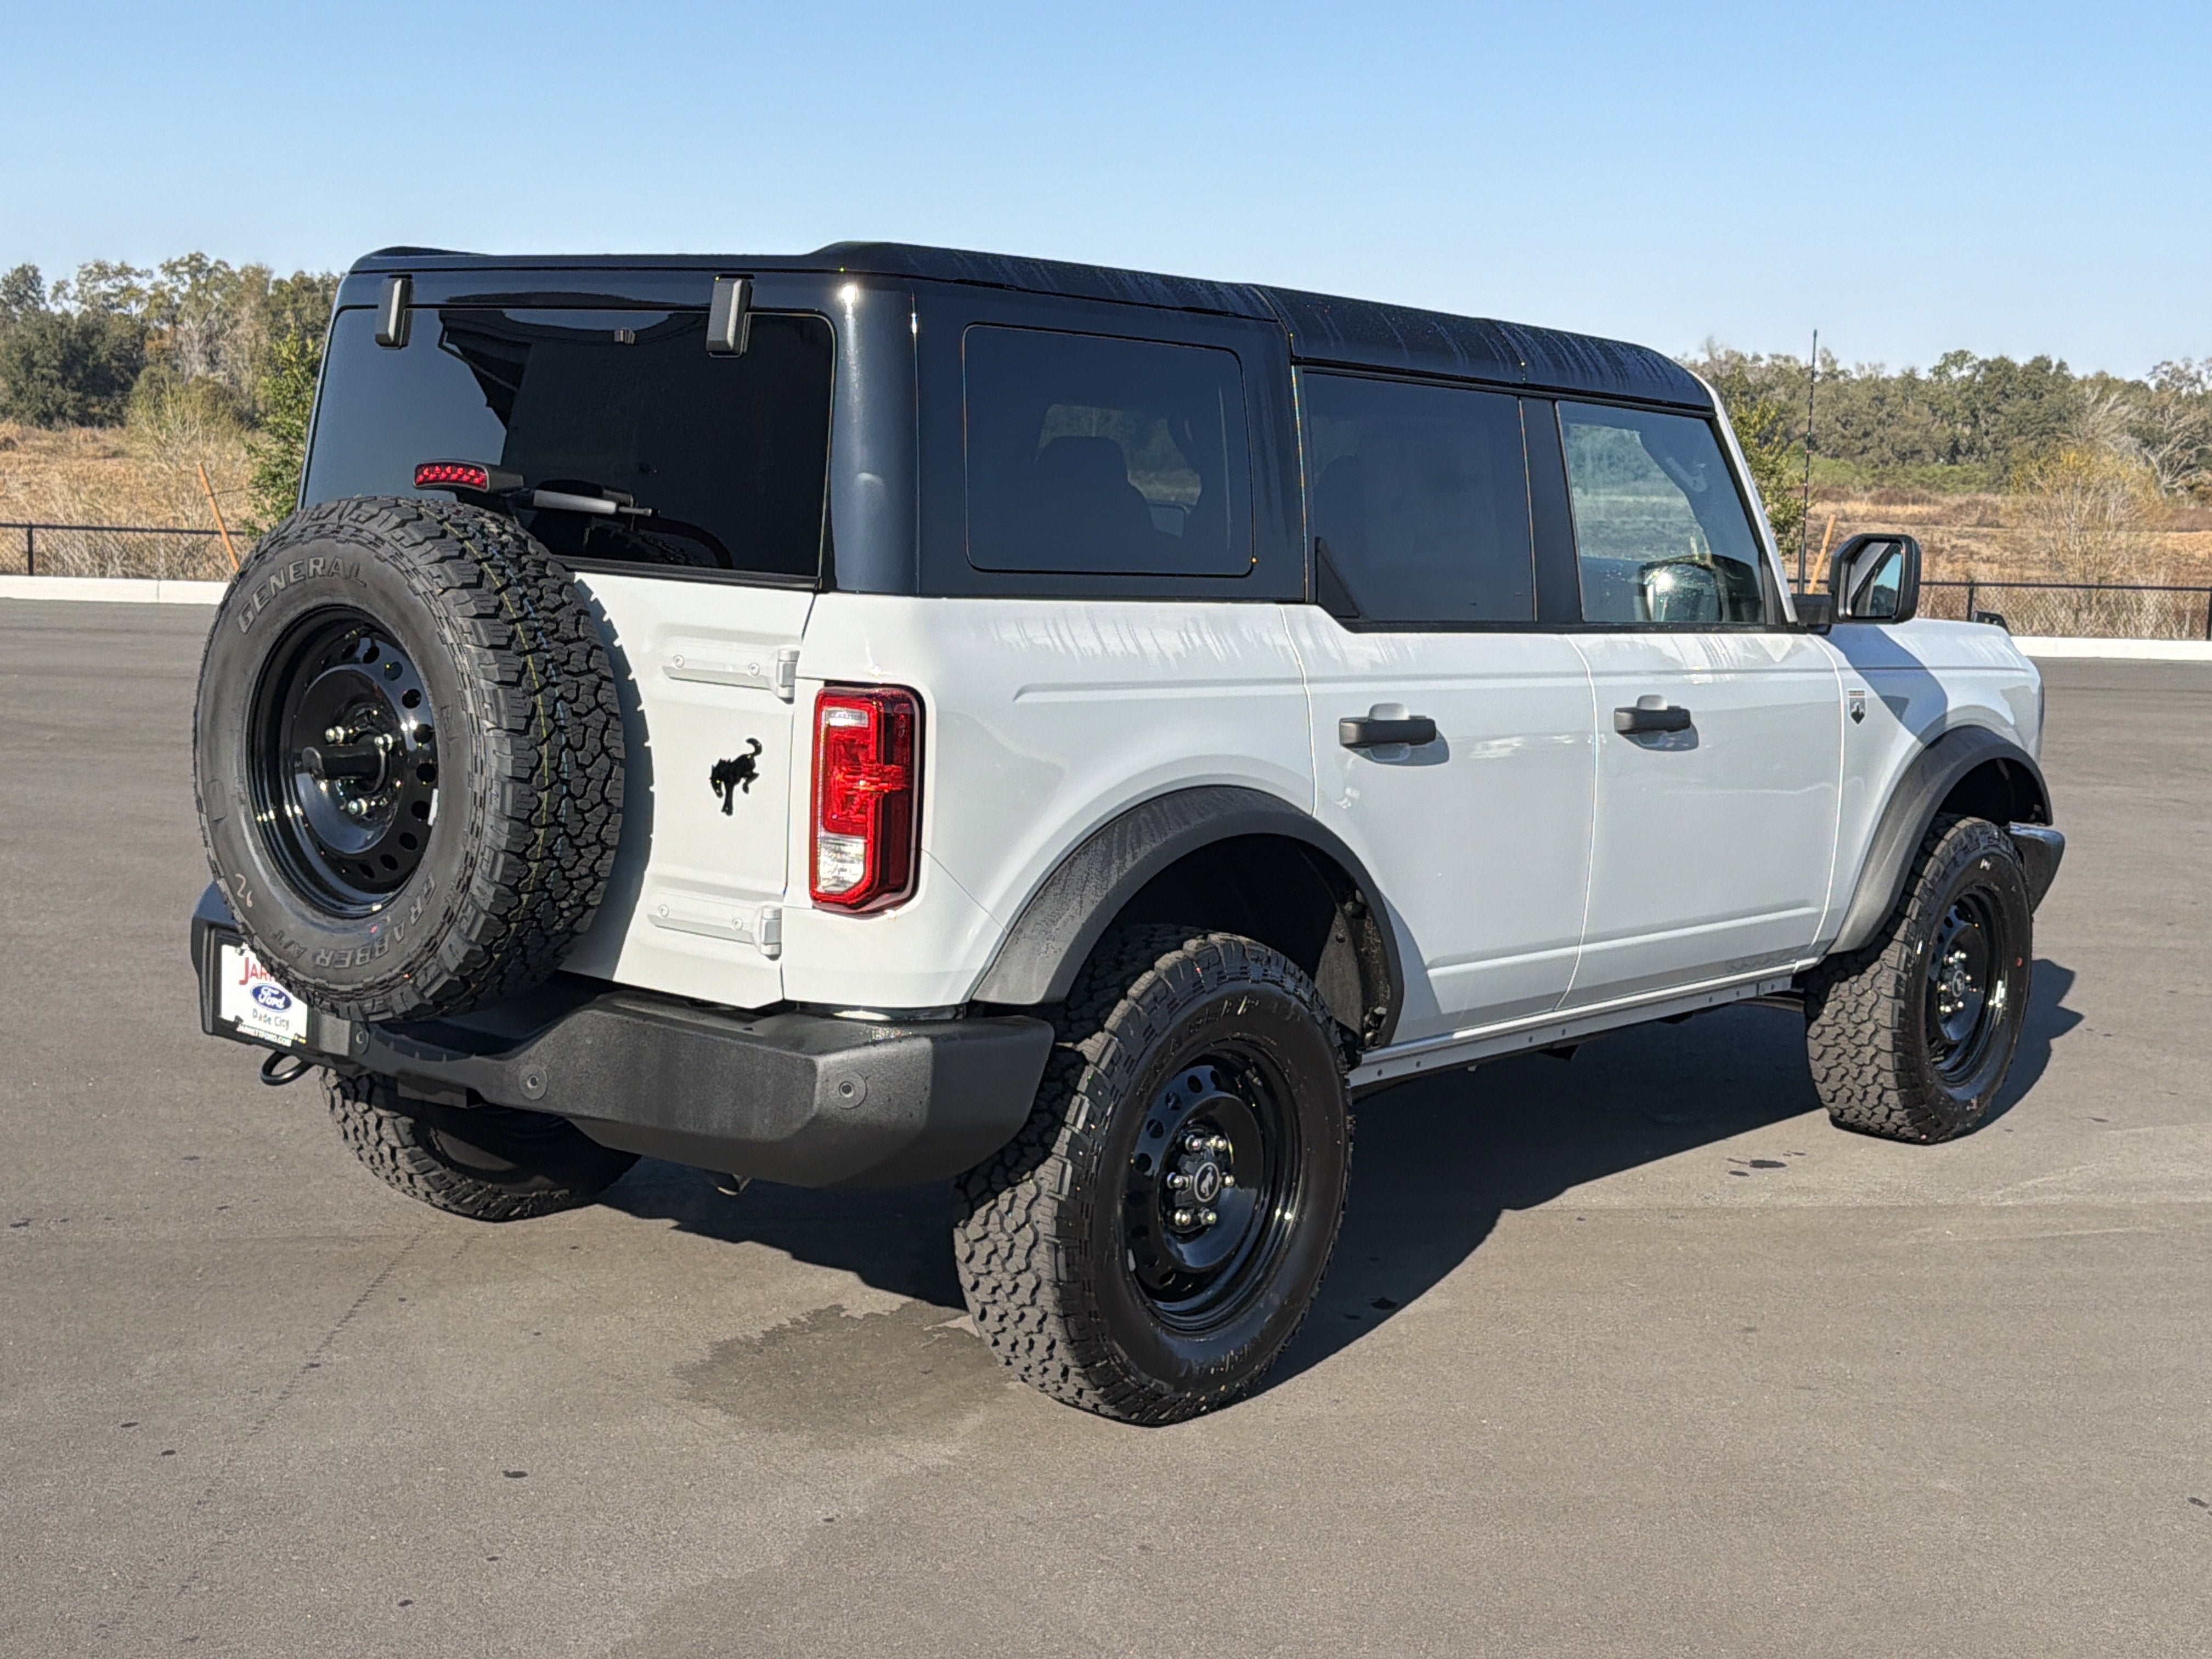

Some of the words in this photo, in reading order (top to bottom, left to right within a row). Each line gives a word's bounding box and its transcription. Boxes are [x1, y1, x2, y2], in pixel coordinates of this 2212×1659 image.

[237, 556, 368, 635] GENERAL
[314, 871, 437, 969] GRABBER
[252, 1008, 272, 1025] Dade
[274, 1015, 290, 1031] City
[258, 986, 286, 1009] Ford
